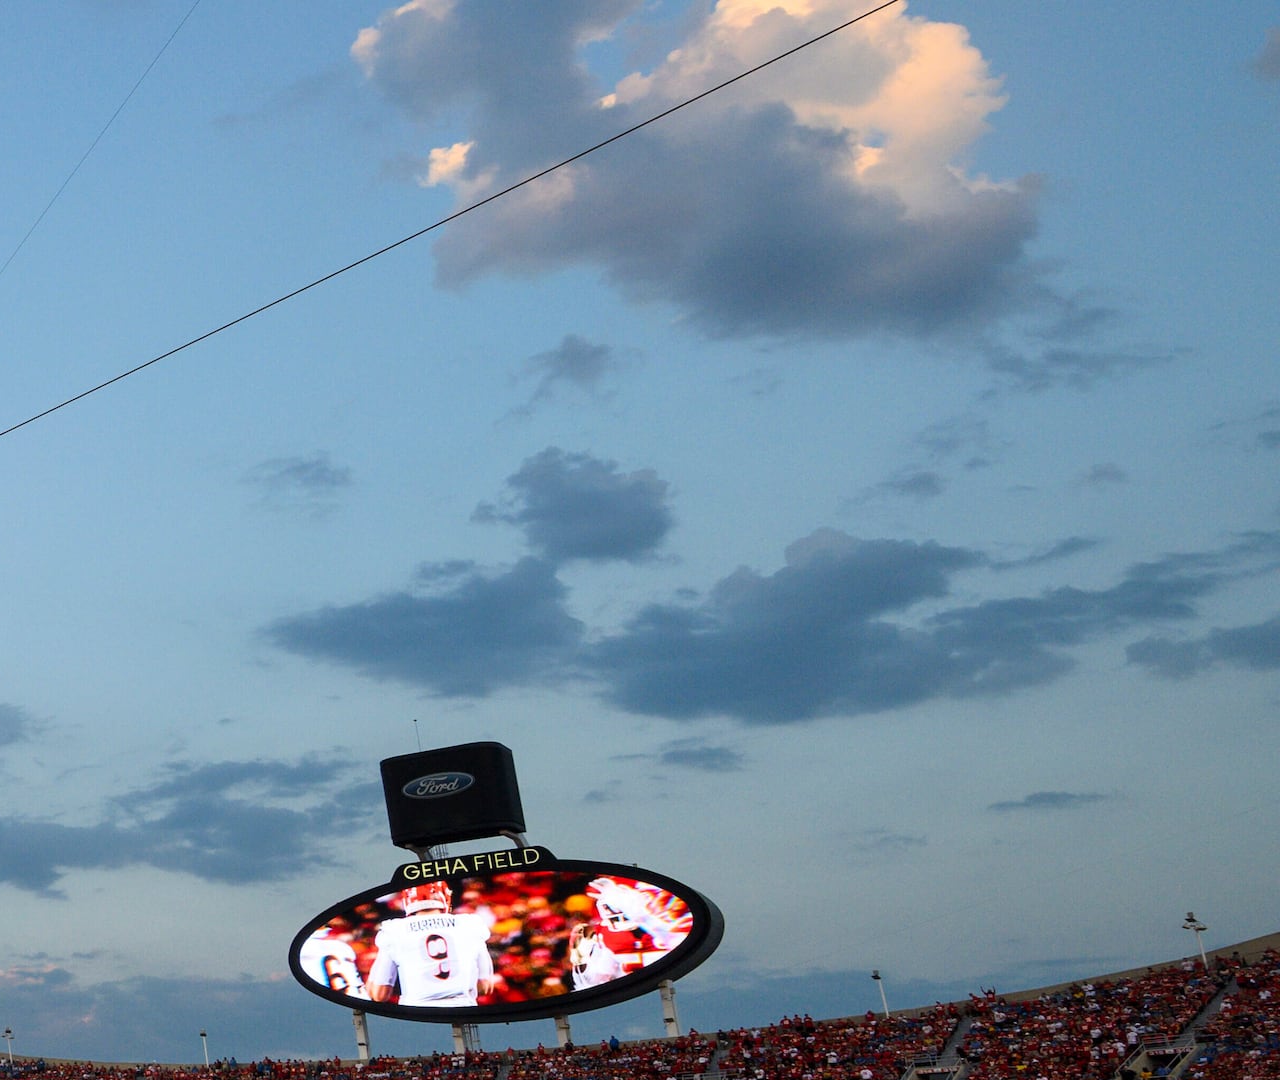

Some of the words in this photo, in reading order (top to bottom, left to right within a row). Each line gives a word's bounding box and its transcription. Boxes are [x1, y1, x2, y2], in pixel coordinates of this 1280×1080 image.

[416, 776, 459, 796] Ford
[403, 858, 469, 880] GEHA
[473, 848, 540, 872] FIELD
